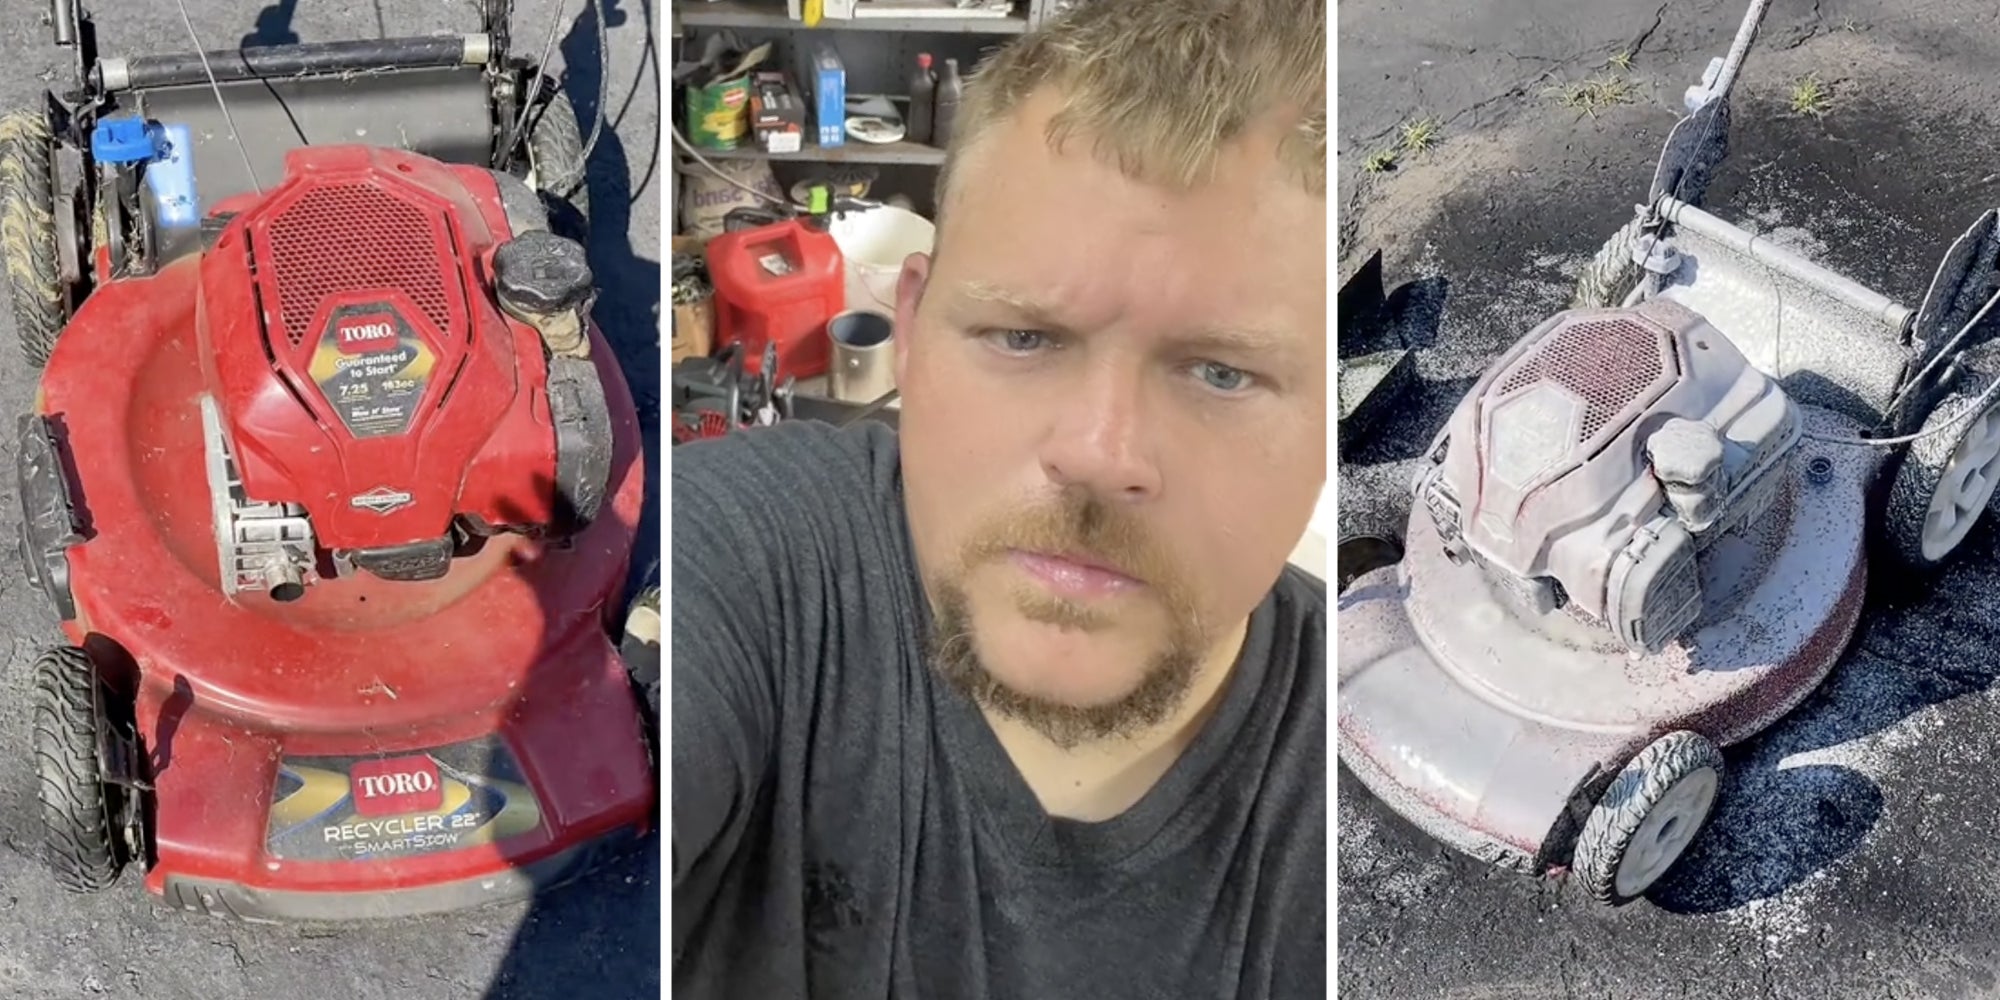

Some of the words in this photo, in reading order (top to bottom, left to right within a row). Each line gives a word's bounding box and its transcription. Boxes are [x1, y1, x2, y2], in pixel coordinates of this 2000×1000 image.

[340, 323, 394, 341] TORO
[335, 351, 407, 369] Guaranteed
[350, 368, 363, 378] to
[366, 364, 395, 376] Start
[339, 383, 369, 396] 7.25
[359, 771, 435, 797] TORO
[324, 815, 443, 843] RECYCLER
